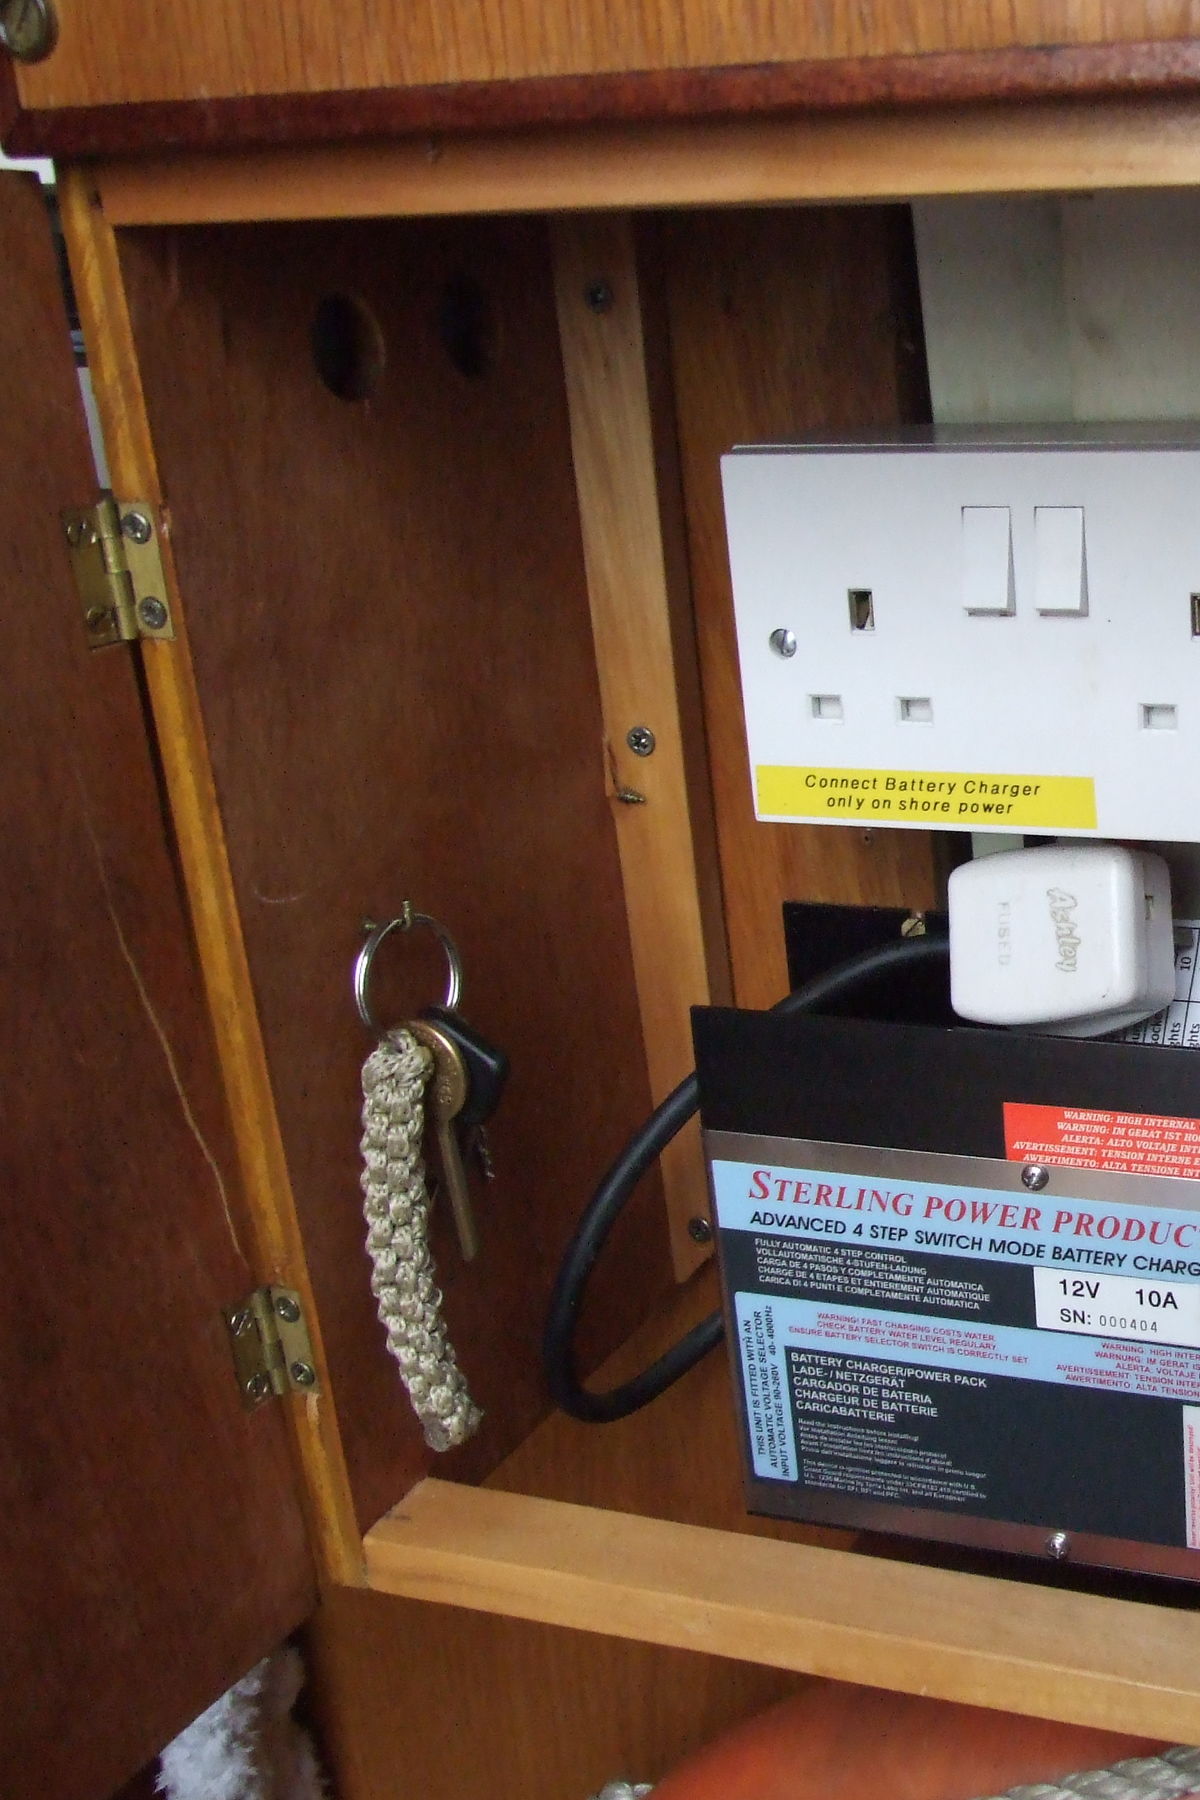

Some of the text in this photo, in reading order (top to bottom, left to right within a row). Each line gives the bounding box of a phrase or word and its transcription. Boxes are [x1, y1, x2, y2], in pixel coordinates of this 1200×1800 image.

[804, 774, 1041, 798] Connect Battery Charger
[826, 795, 1014, 816] only on shore power
[997, 901, 1011, 967] FUSED
[1046, 886, 1078, 974] Ashley
[1180, 956, 1192, 972] 10
[1063, 1110, 1112, 1123] WARNING:
[1116, 1115, 1141, 1125] HIGH
[1144, 1117, 1195, 1131] INTERNAL
[1060, 1133, 1104, 1146] ALERTA:
[1106, 1137, 1132, 1148] ALTO
[1136, 1140, 1176, 1152] VOLTAJE
[744, 1167, 916, 1218] STERLING
[921, 1194, 1043, 1231] POWER
[748, 1209, 847, 1235] ADVANCED
[852, 1221, 863, 1237] 4
[868, 1223, 909, 1242] STEP
[913, 1228, 984, 1251] SWITCH
[987, 1237, 1047, 1259] MODE
[1051, 1245, 1128, 1268] BATTERY
[754, 1237, 906, 1264] FULLY AUTOMATIC STEP CONTROL
[1058, 1277, 1178, 1310] 12V 10A
[742, 1319, 751, 1334] AN
[1059, 1307, 1157, 1333] SN: 000404
[747, 1363, 759, 1397] FITTED
[790, 1351, 987, 1388] BATTERY CHARGER/POWER PACK
[753, 1310, 778, 1468] AUTOMATIC VOLTAGE SELECTOR
[792, 1375, 932, 1404] CARGADOR DE BATERIA
[793, 1388, 938, 1417] CHARGEUR DE BATTERIE
[753, 1411, 763, 1433] UNIT
[794, 1399, 895, 1423] CARICABATTERIE
[756, 1434, 766, 1455] THIS
[774, 1402, 789, 1477] INPUT VOLTAGE
